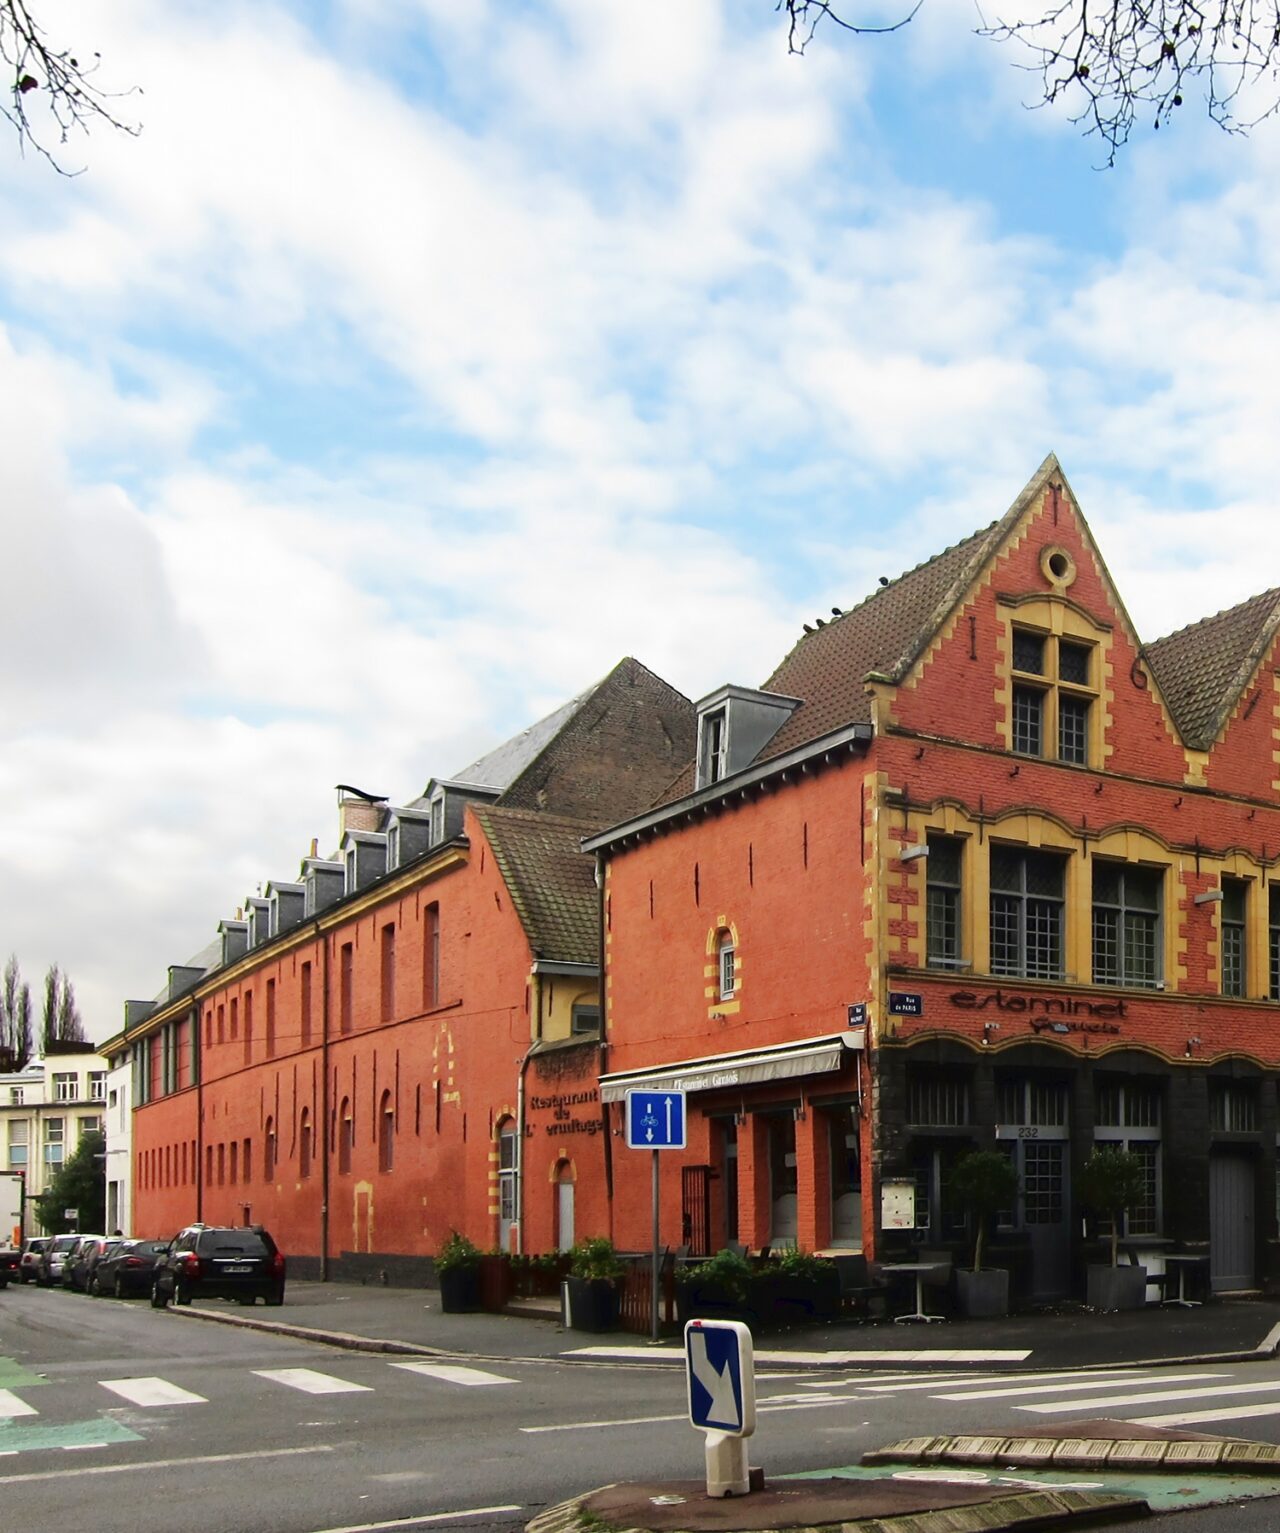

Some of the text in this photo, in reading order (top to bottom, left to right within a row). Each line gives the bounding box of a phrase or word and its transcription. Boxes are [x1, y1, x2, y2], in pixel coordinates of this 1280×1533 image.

[902, 1004, 916, 1012] PARIS
[530, 1089, 599, 1110] Restaurant
[553, 1109, 570, 1121] de
[1018, 1127, 1038, 1138] 232
